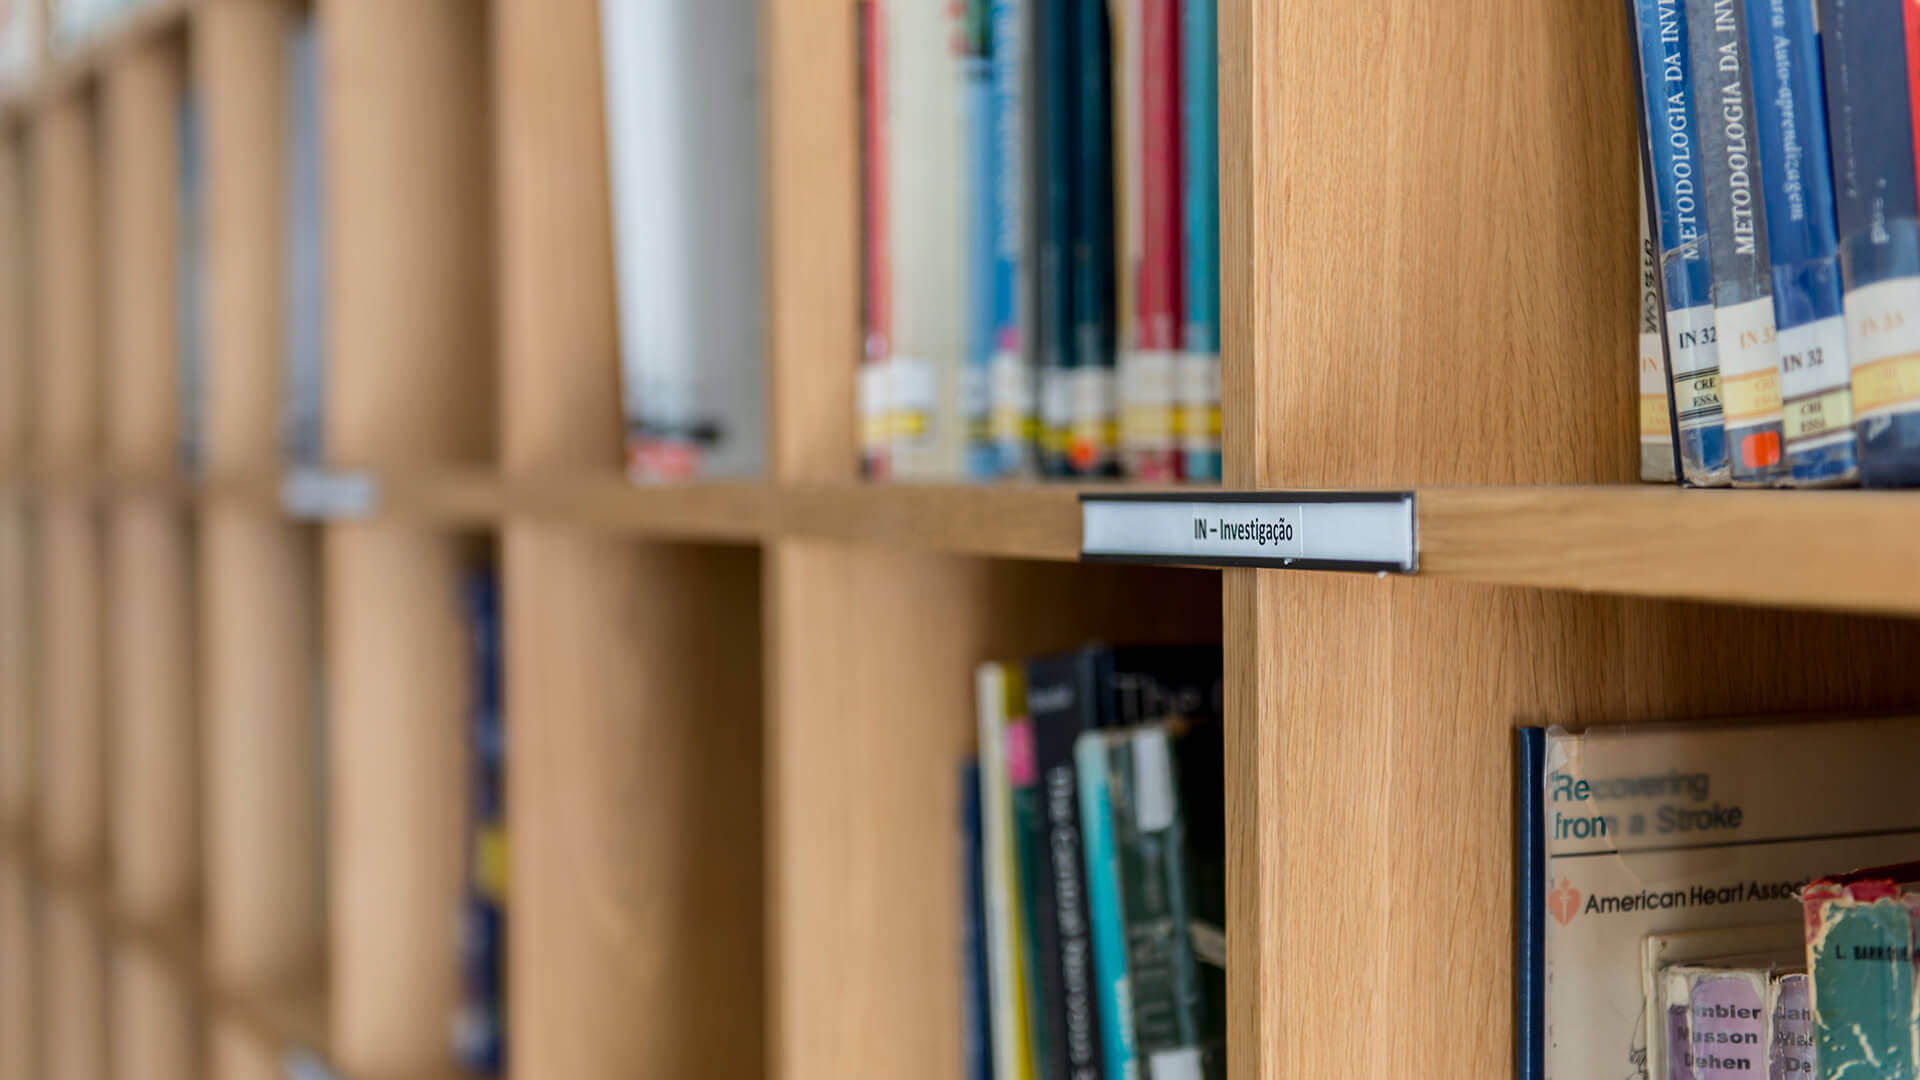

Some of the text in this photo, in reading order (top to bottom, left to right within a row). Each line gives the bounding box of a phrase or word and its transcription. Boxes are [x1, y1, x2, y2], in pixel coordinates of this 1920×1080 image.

[1663, 52, 1683, 82] DA
[1718, 40, 1740, 72] DA
[1667, 91, 1700, 260] METODOLOGIA
[1722, 81, 1756, 255] METODOLOGIA
[1679, 326, 1717, 349] IN 32
[1783, 346, 1825, 373] IN 32
[1693, 377, 1715, 391] CRE
[1692, 393, 1719, 408] ESSA
[1194, 518, 1207, 540] IN
[1220, 517, 1293, 546] Investigação
[1656, 804, 1742, 835] Stroke
[1585, 889, 1686, 915] American
[1689, 880, 1743, 907] Heart
